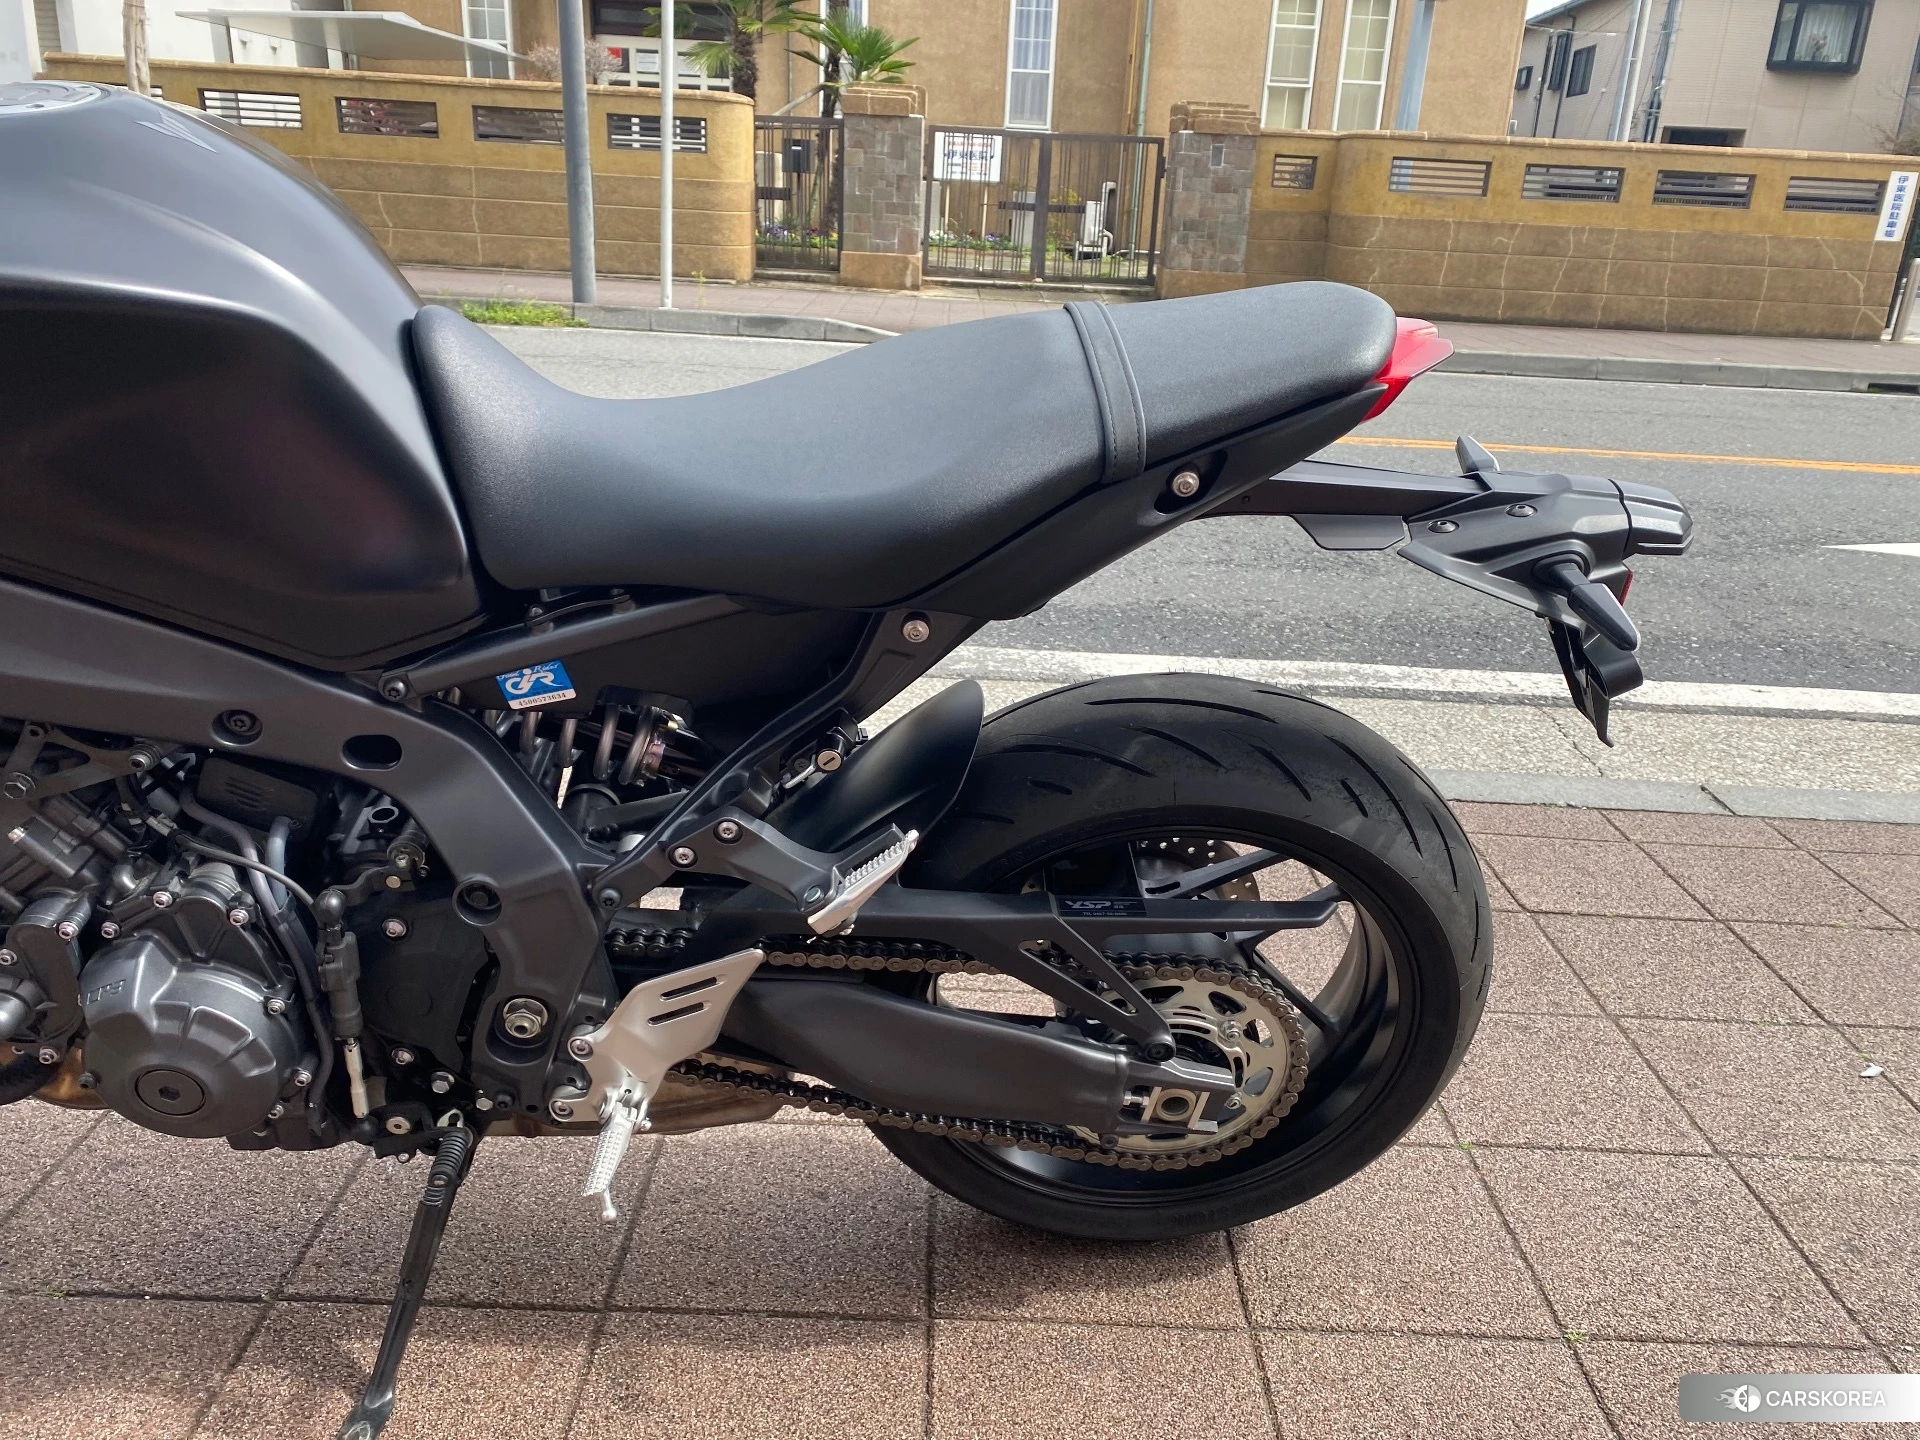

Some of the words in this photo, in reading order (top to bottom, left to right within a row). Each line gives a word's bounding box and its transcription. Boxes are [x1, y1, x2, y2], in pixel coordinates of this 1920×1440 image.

[1884, 175, 1910, 238] 伊東医院駐車場
[1064, 900, 1112, 909] YSP
